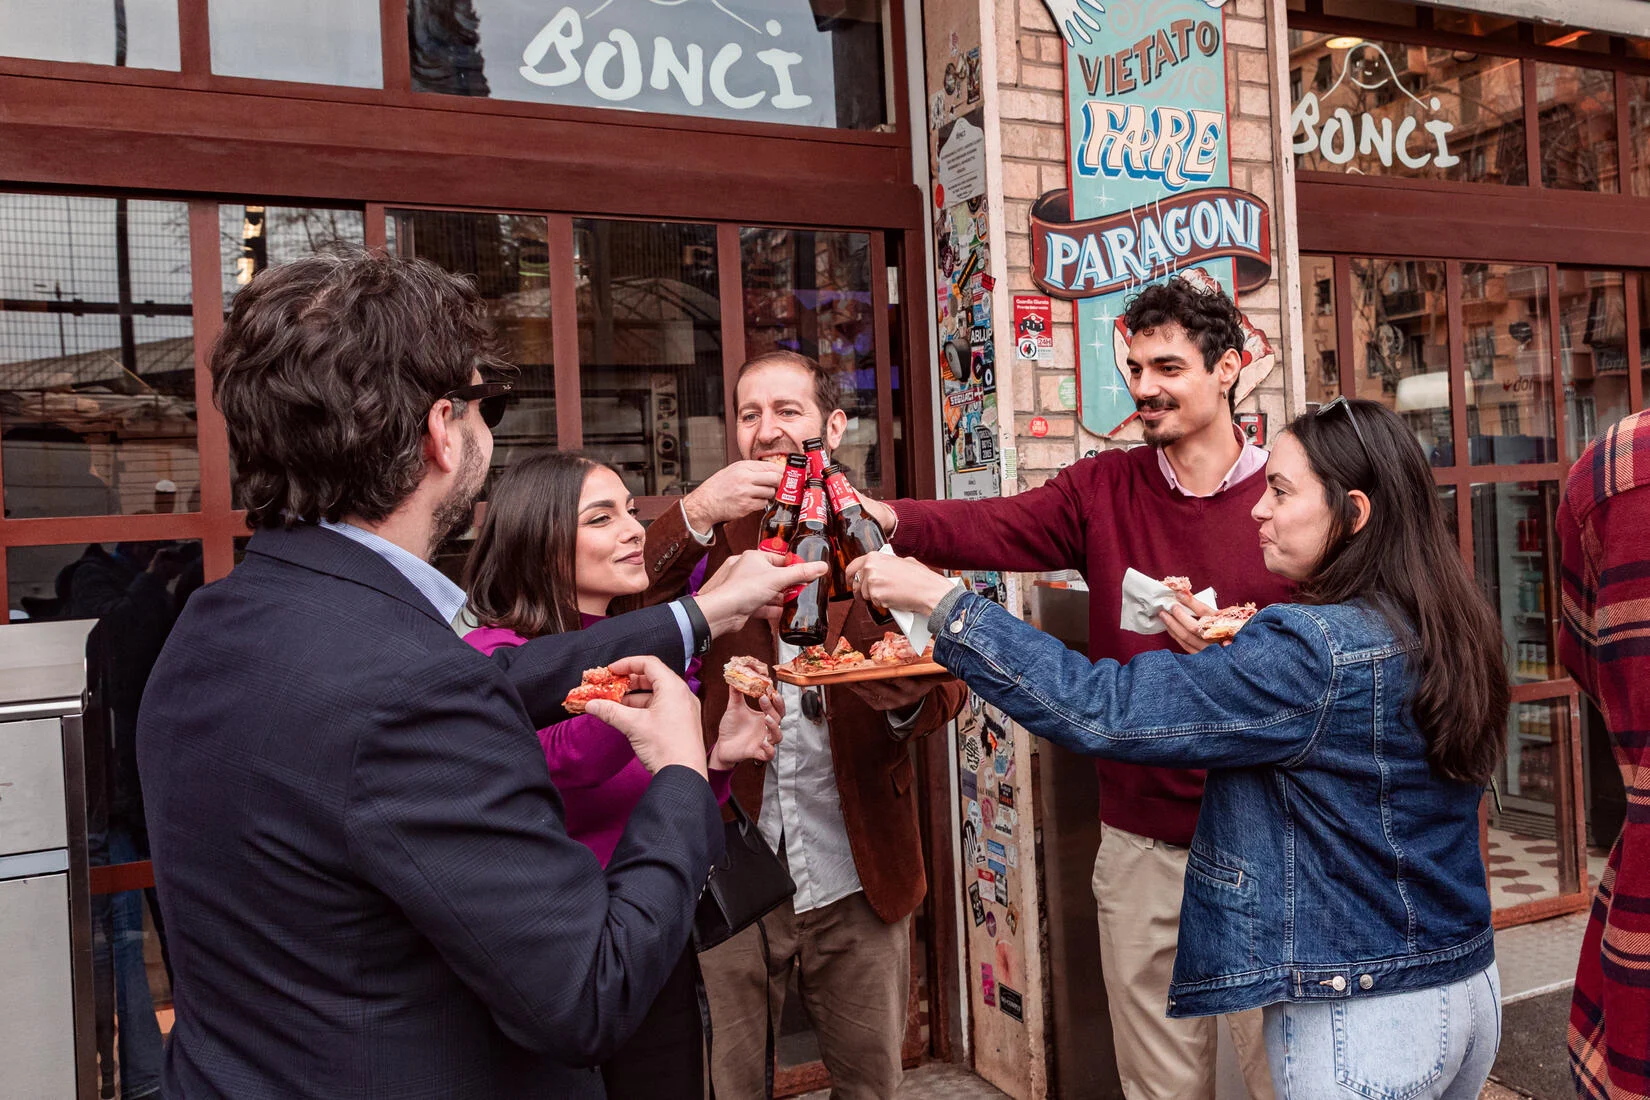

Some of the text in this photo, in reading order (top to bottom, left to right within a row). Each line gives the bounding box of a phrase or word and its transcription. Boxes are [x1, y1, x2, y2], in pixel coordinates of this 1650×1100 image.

[519, 6, 812, 109] BONCI
[1077, 19, 1219, 96] VIETATO
[1077, 101, 1224, 192] FARE
[1292, 92, 1460, 169] BONCI
[1045, 198, 1262, 290] PARAGONI
